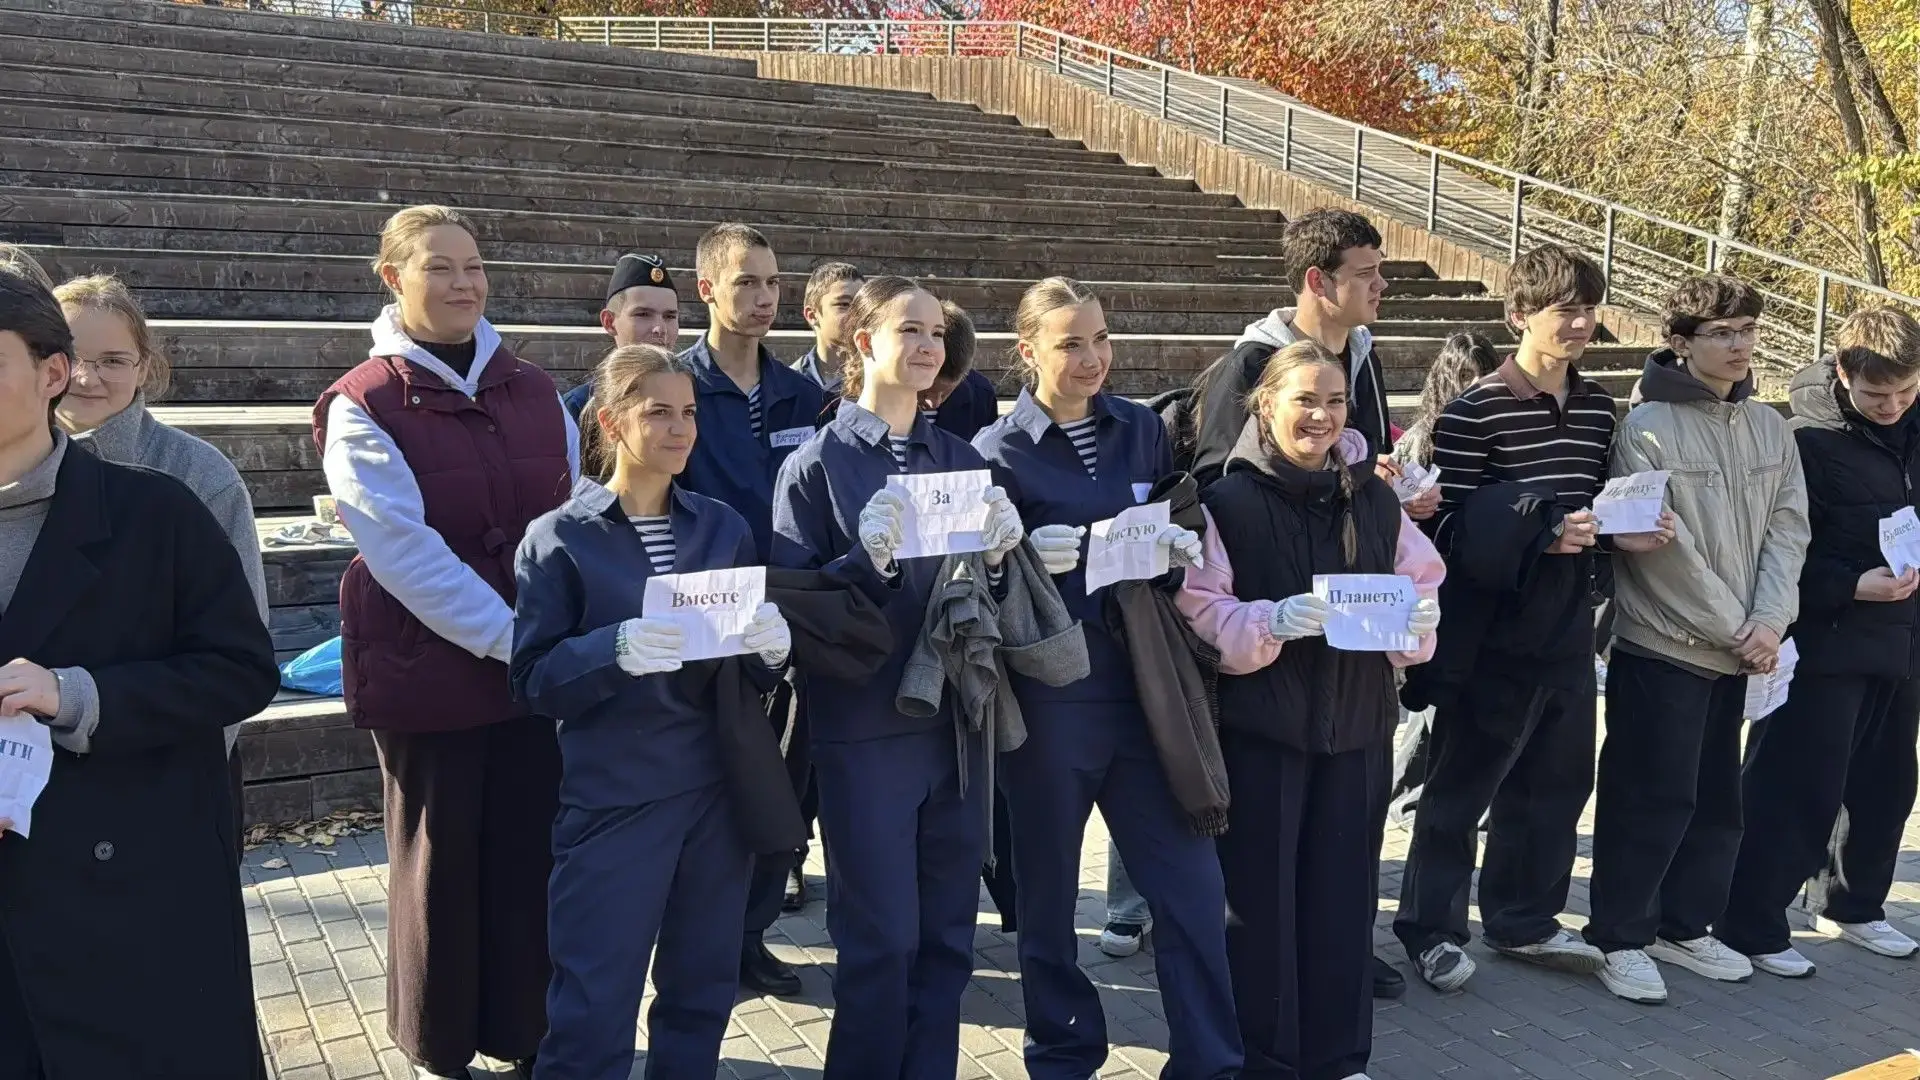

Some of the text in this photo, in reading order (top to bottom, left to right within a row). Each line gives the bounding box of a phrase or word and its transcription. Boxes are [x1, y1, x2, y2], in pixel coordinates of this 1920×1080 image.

[931, 489, 950, 505] За
[671, 592, 739, 608] Вместе
[1329, 589, 1404, 606] Планету!
